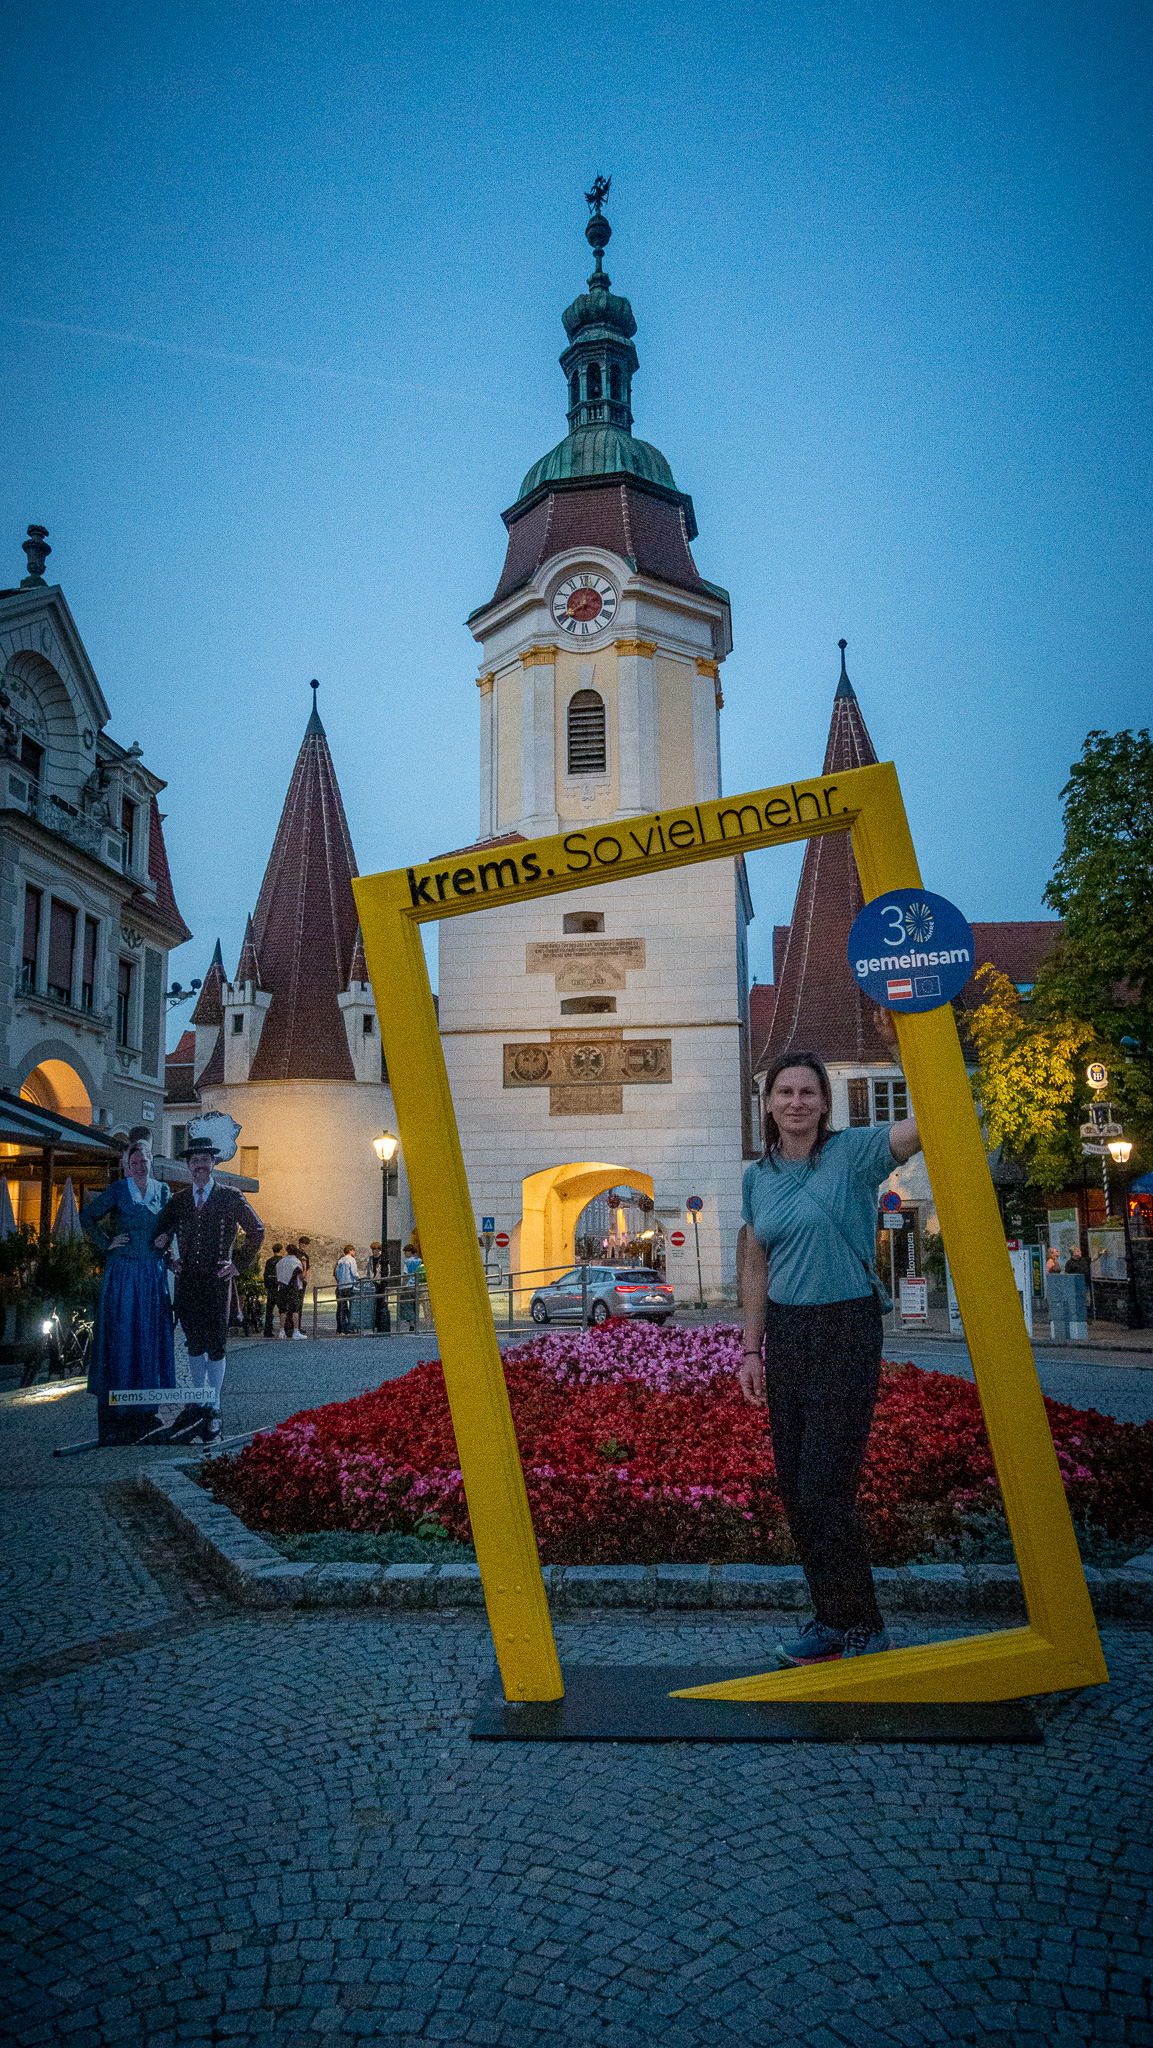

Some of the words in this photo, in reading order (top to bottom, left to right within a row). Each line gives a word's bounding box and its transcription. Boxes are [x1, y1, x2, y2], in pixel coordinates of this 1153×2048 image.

[406, 852, 554, 907] krems.
[564, 833, 622, 871] So
[630, 806, 705, 856] viel
[717, 785, 848, 839] mehr.
[924, 921, 935, 942] JAHRE
[855, 948, 970, 977] gemeinsam
[1092, 1072, 1103, 1081] HB
[906, 1231, 916, 1278] llkommen
[111, 1391, 146, 1402] krems.
[148, 1390, 162, 1401] So
[164, 1389, 182, 1400] viel
[184, 1388, 216, 1400] mehr.
